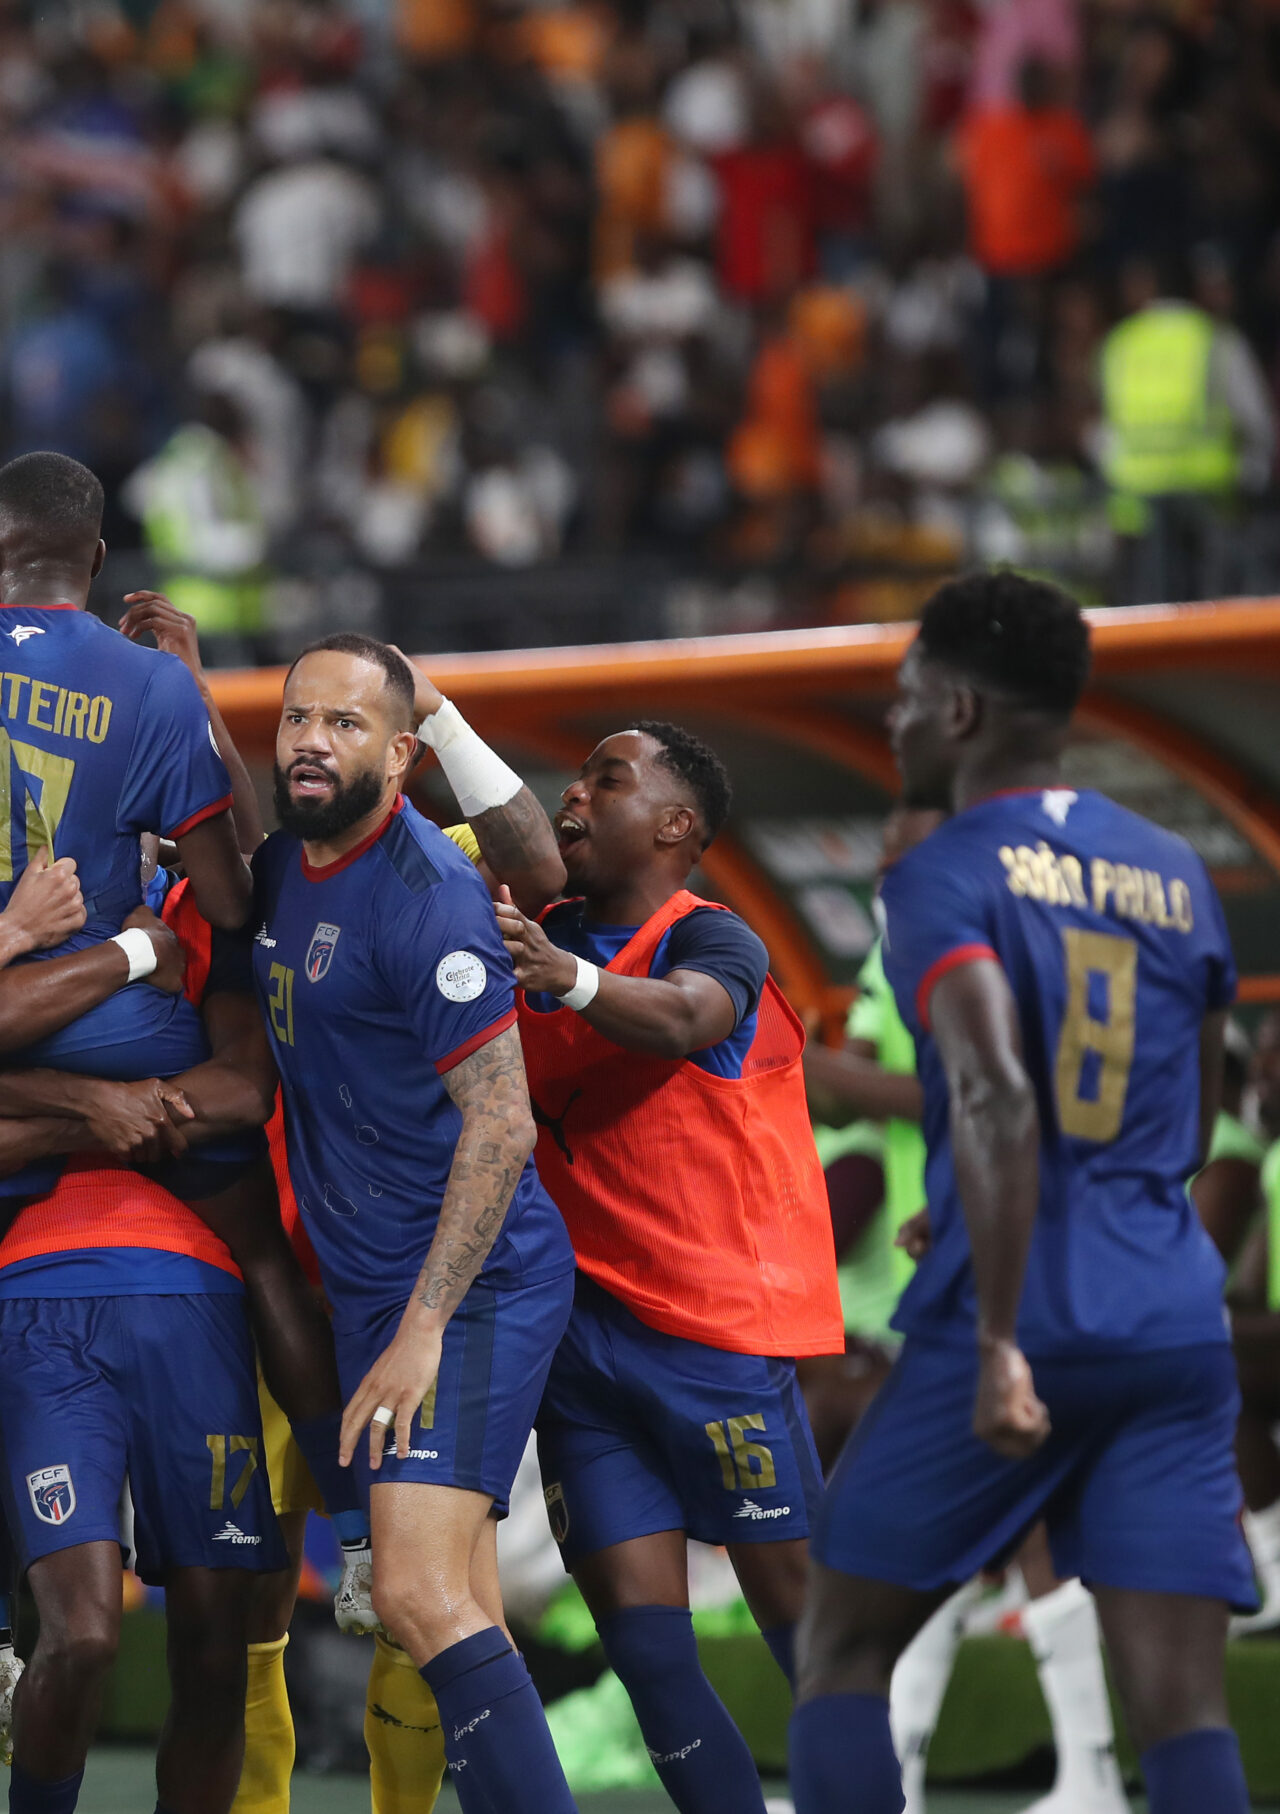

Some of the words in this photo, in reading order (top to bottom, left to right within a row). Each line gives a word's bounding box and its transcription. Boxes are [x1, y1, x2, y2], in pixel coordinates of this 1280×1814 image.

[317, 925, 338, 937] FCF
[269, 961, 295, 1048] 21
[1053, 926, 1138, 1143] 8
[206, 1434, 258, 1511] 17
[705, 1413, 777, 1491] 16
[30, 1468, 64, 1486] FCF
[751, 1506, 791, 1520] tempo
[231, 1534, 262, 1546] temp
